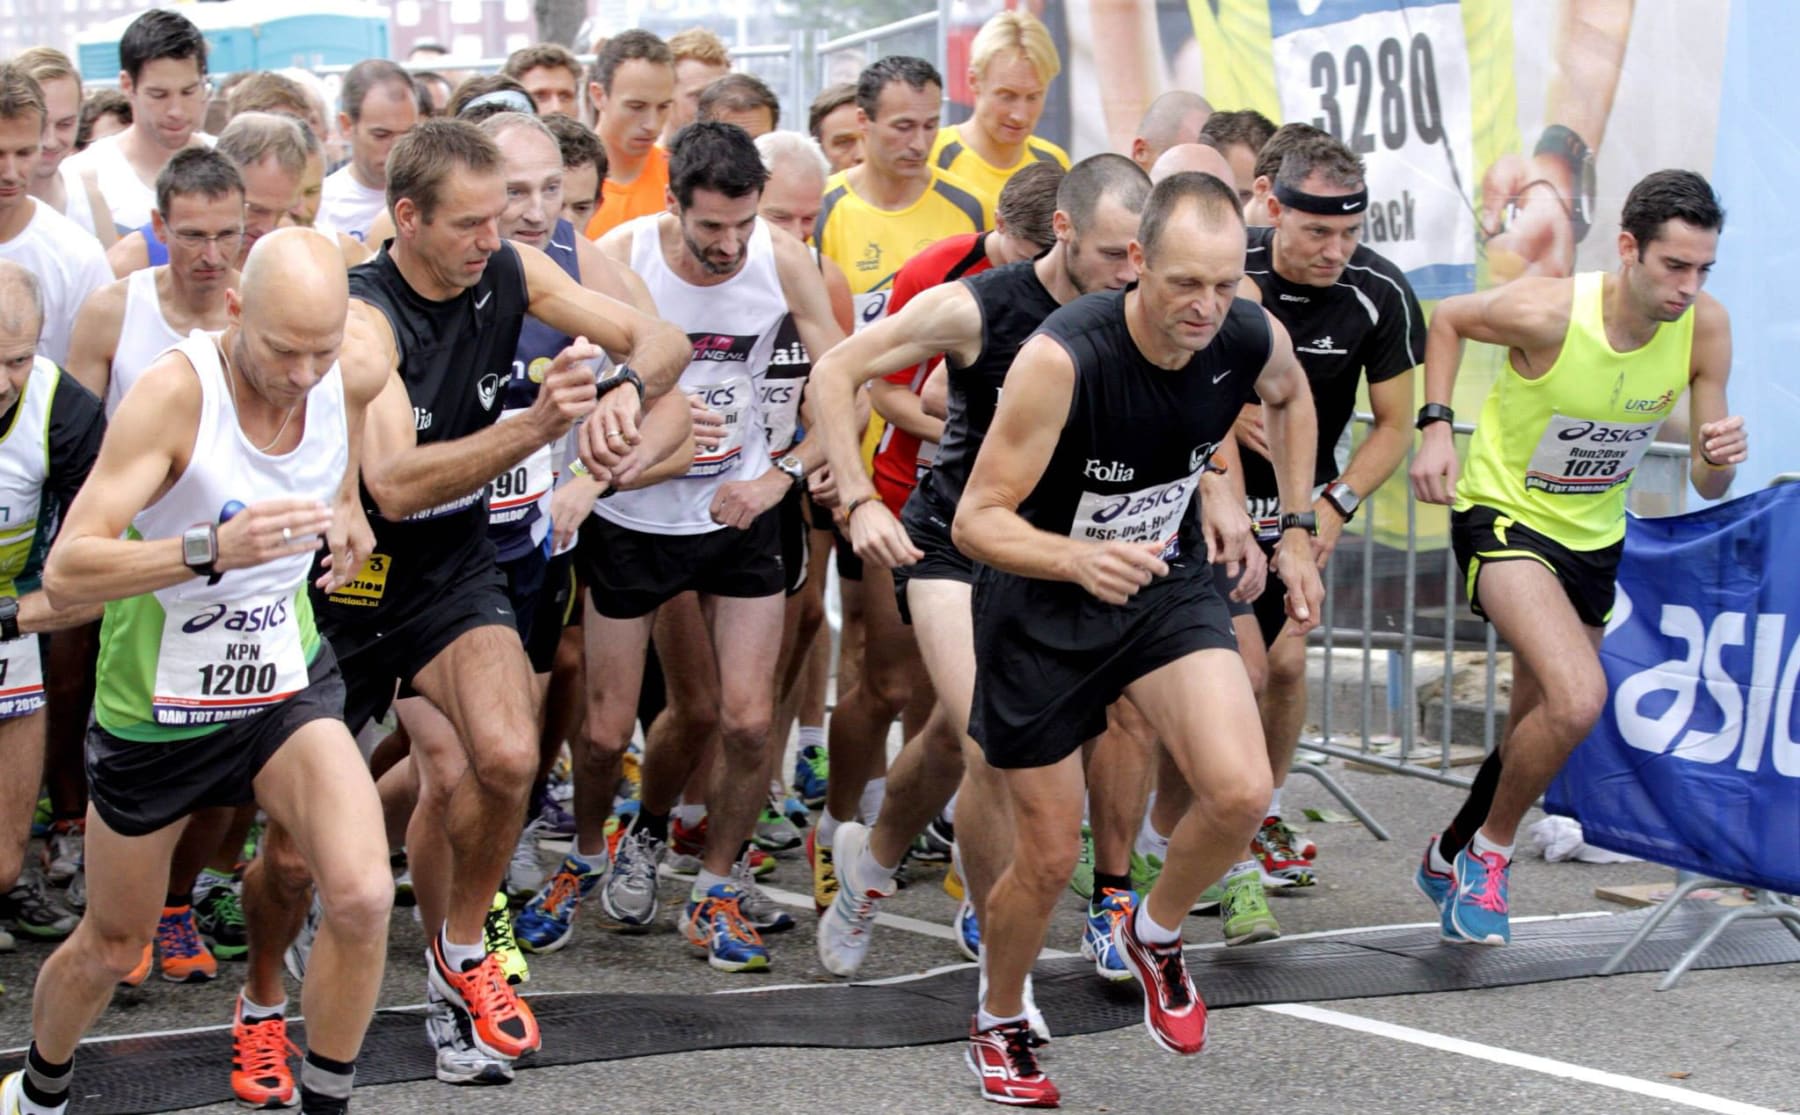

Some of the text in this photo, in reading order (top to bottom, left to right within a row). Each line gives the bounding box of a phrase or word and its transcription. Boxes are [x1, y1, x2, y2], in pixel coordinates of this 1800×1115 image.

[1310, 32, 1441, 153] 3280
[1569, 447, 1628, 459] Run2Day
[1083, 458, 1134, 482] Folia
[1563, 460, 1620, 477] 1073
[370, 557, 384, 571] 3
[226, 643, 260, 660] KPN
[199, 662, 277, 695] 1200
[158, 709, 188, 724] DAM
[189, 710, 213, 724] TOT
